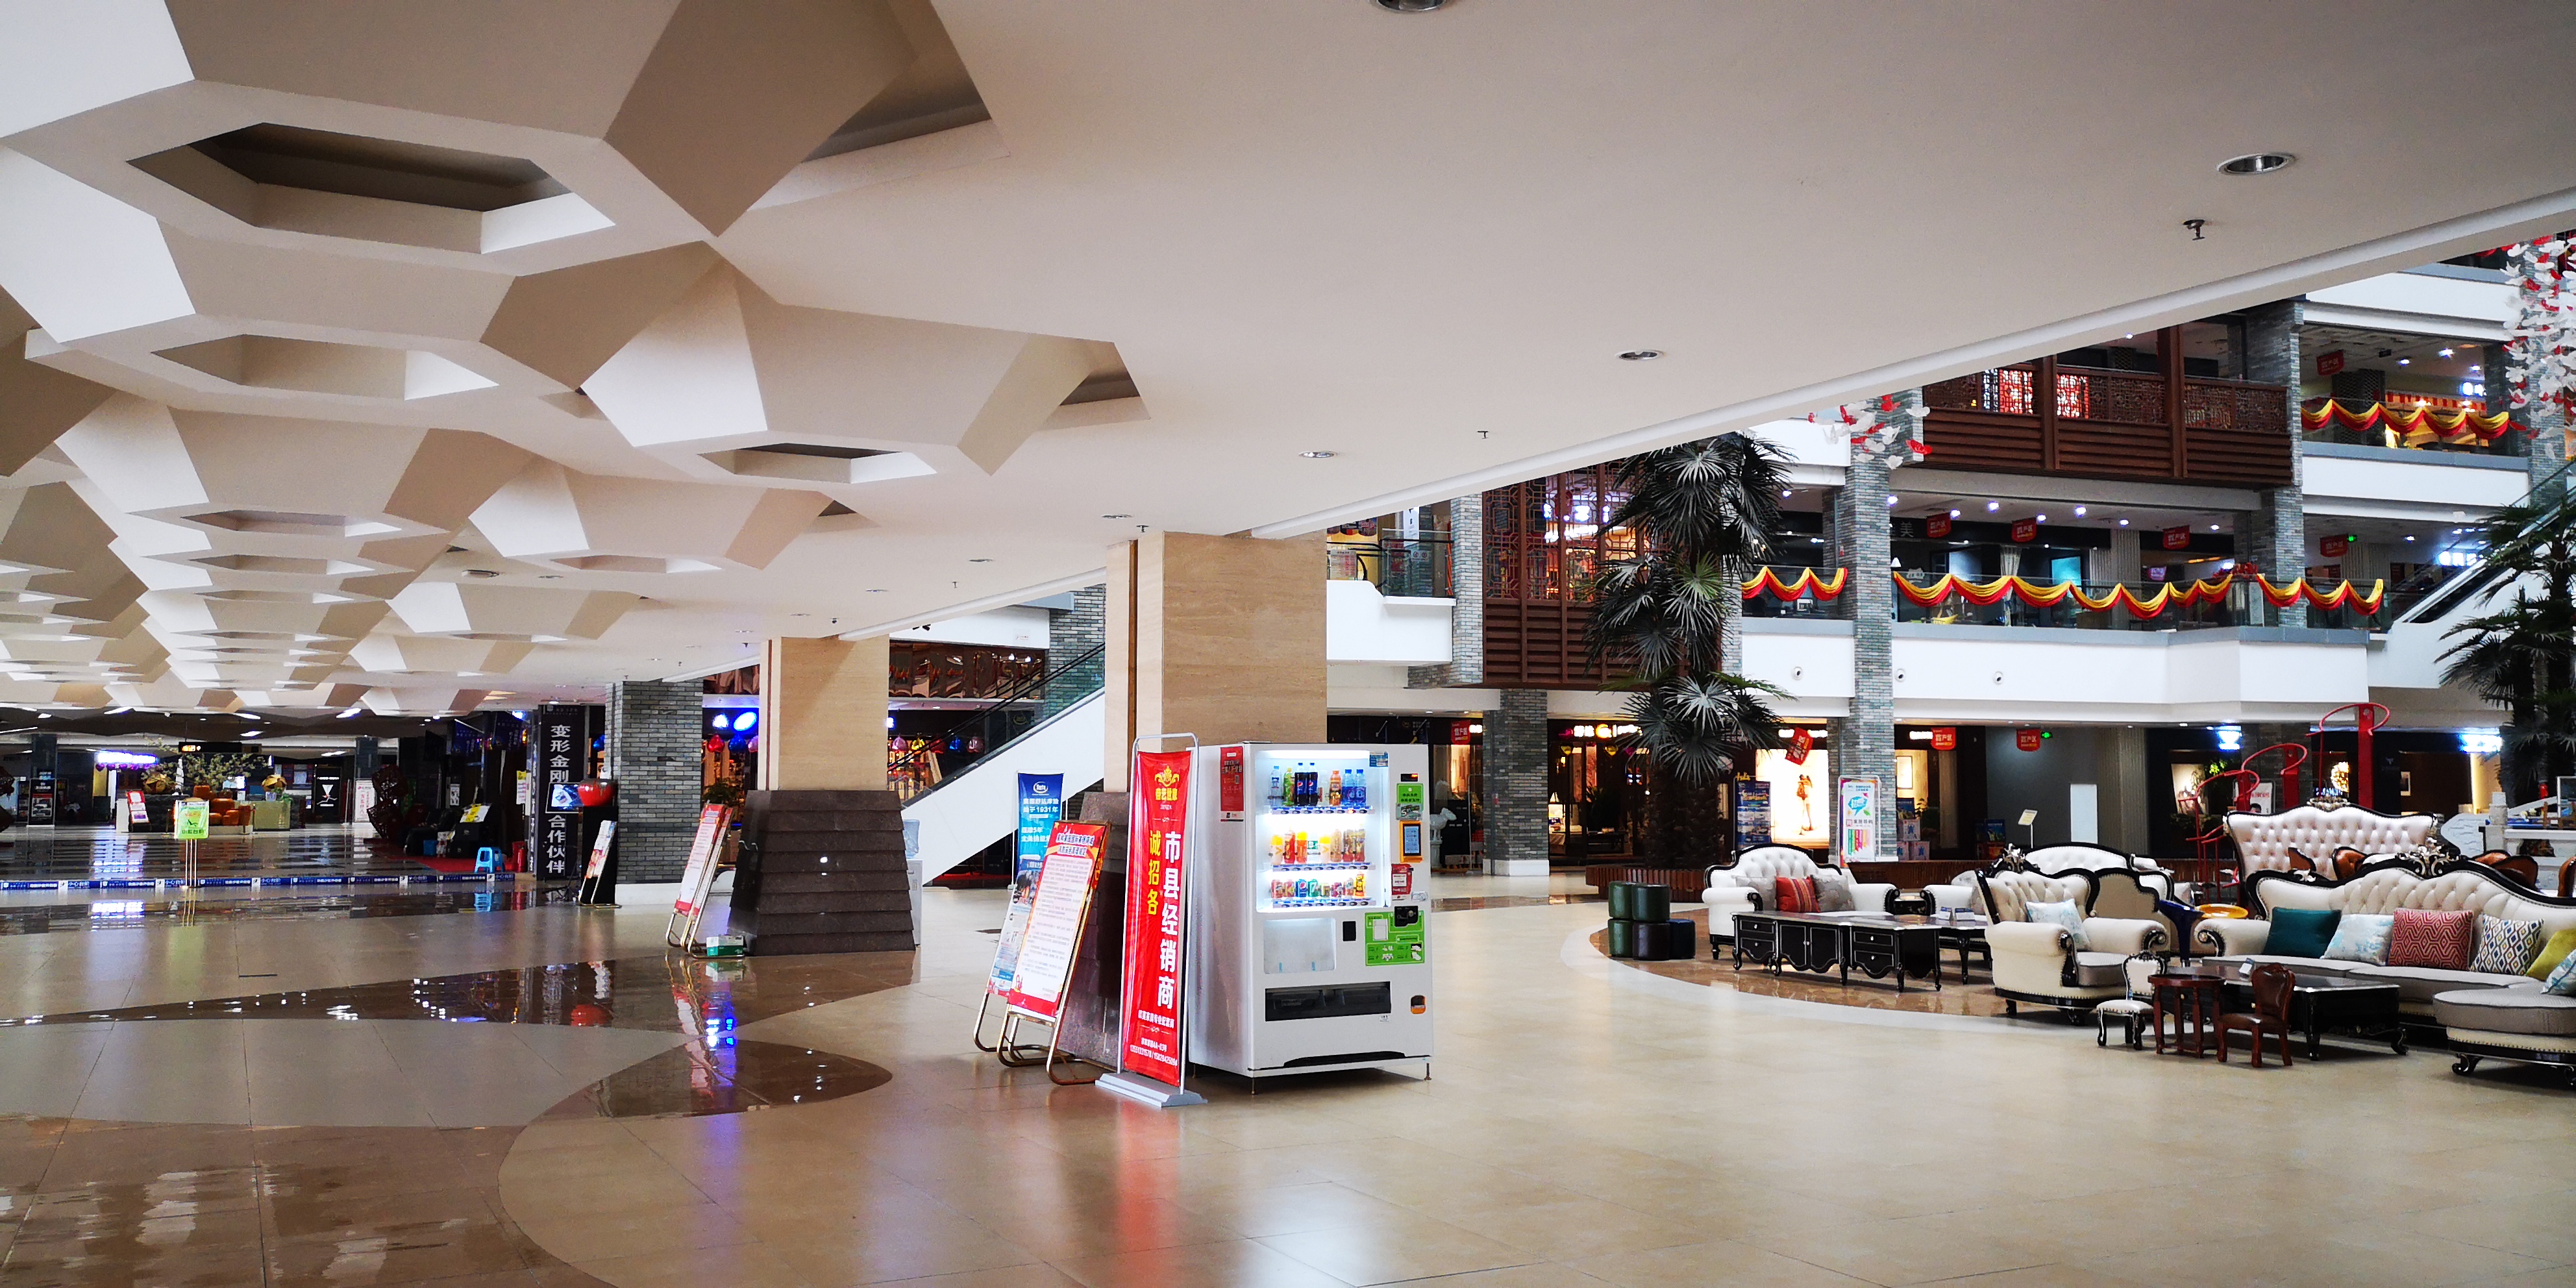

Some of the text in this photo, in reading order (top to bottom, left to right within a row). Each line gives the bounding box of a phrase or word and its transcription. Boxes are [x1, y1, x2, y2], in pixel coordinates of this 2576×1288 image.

[546, 724, 571, 874] 变形金刚 合作伙伴
[1147, 830, 1161, 915] 诚招各
[1158, 832, 1181, 1009] 市县经销商
